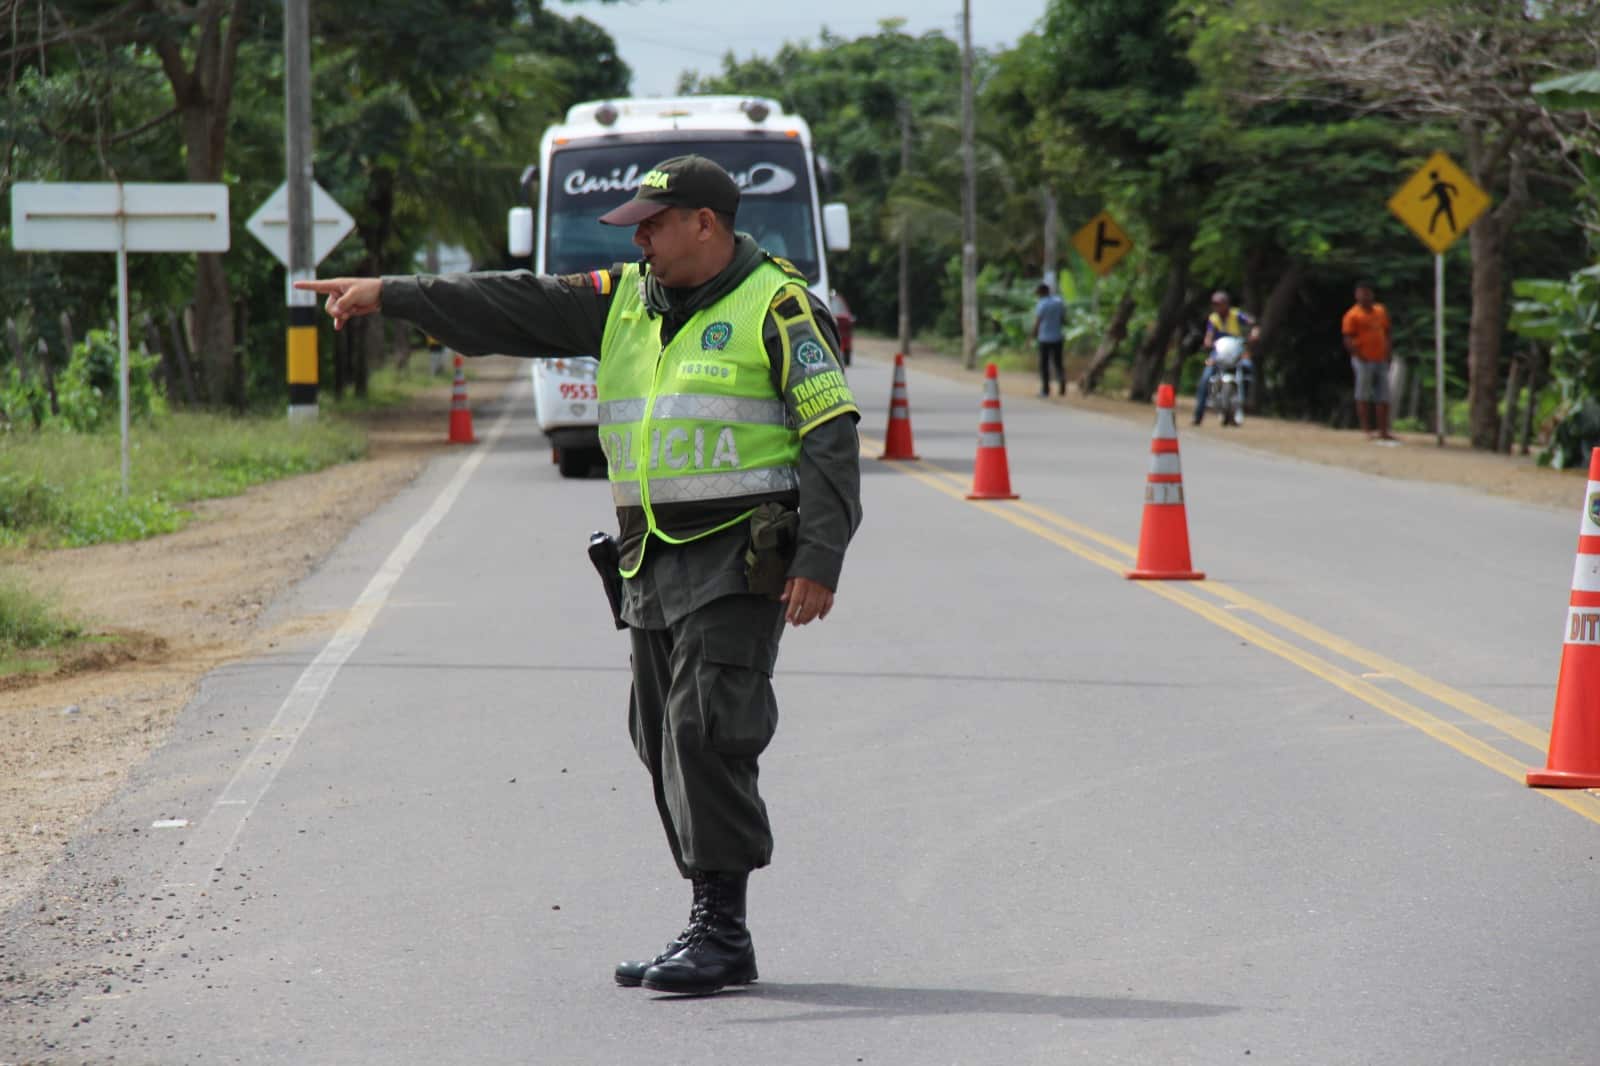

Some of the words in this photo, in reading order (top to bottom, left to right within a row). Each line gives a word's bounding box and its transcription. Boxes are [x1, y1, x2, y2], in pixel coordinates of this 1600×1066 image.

[564, 164, 646, 195] Carib
[643, 170, 669, 190] CIA
[1570, 613, 1600, 641] DIT
